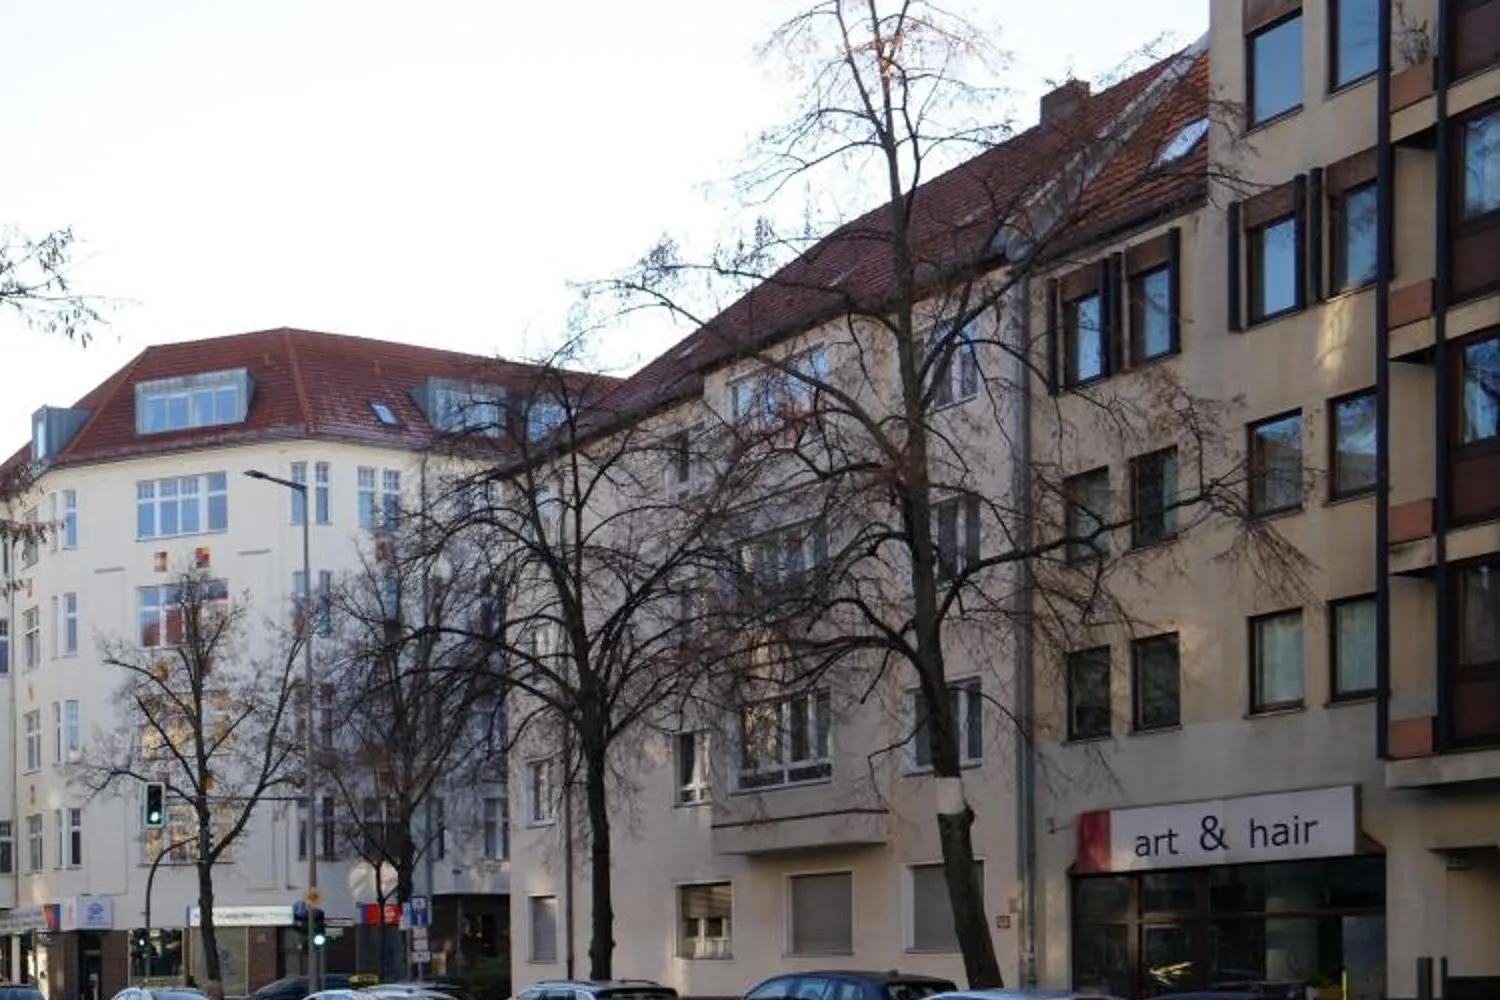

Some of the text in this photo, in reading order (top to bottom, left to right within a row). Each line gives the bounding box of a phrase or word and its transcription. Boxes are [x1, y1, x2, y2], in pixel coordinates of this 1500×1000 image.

[1134, 814, 1319, 858] art & hair
